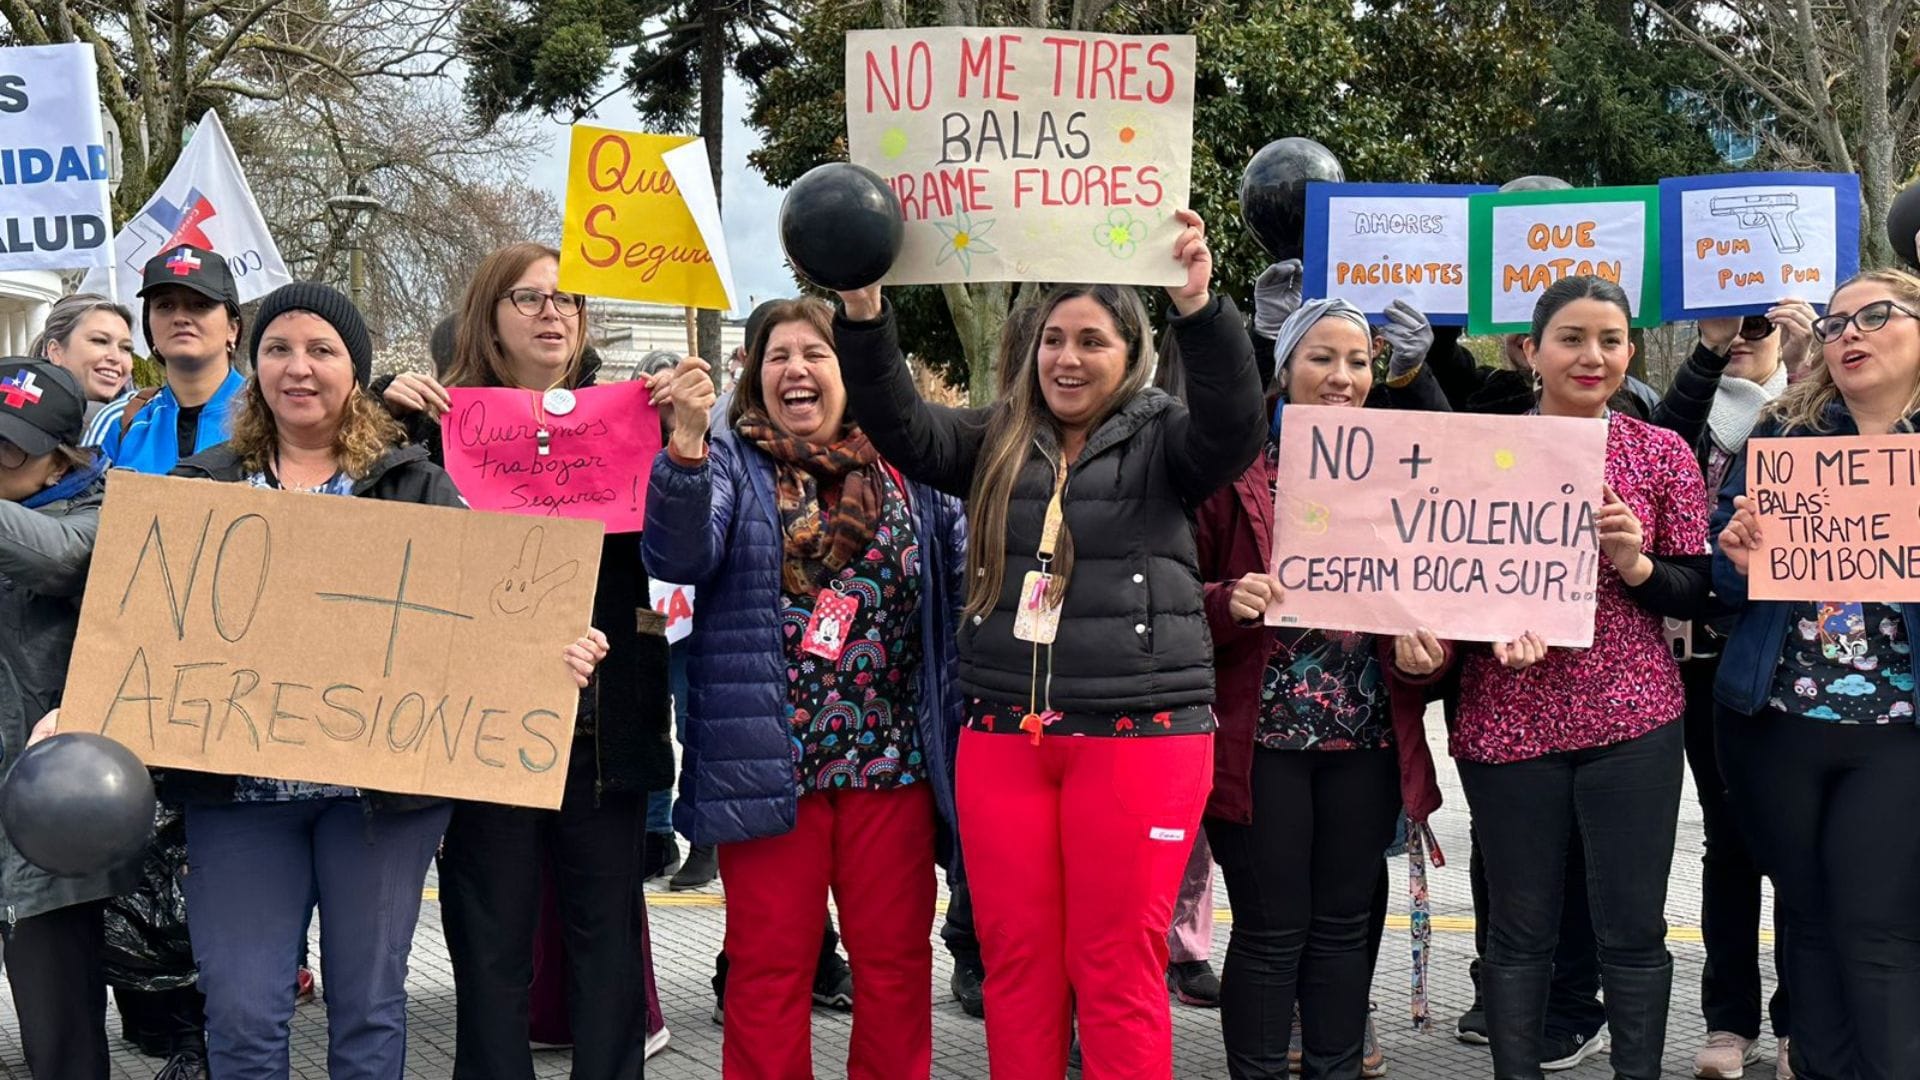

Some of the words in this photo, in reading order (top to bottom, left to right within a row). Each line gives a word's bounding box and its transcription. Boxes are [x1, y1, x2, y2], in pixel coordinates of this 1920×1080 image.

[865, 41, 932, 113] NO
[957, 35, 1021, 101] ME
[1043, 37, 1175, 104] TIRES
[935, 110, 1090, 166] BALAS
[0, 145, 108, 185] IDAD
[588, 134, 682, 195] Que
[1014, 166, 1163, 208] FLORES
[1355, 212, 1443, 234] AMORES
[1527, 221, 1597, 251] QUE
[1696, 237, 1750, 260] PUM
[1718, 268, 1764, 289] PUM
[1781, 264, 1820, 284] PUM
[1310, 425, 1374, 481] NO
[1399, 444, 1432, 479] +
[1757, 450, 1794, 485] NO
[1816, 449, 1870, 486] ME
[1877, 448, 1920, 486] TI
[1758, 489, 1822, 515] BALAS
[1779, 513, 1891, 543] TIRAME
[119, 509, 271, 643] NO
[315, 539, 474, 677] +
[1278, 556, 1399, 592] CESFAM
[1413, 556, 1487, 593] BOCA
[101, 647, 560, 774] AGRESIONES
